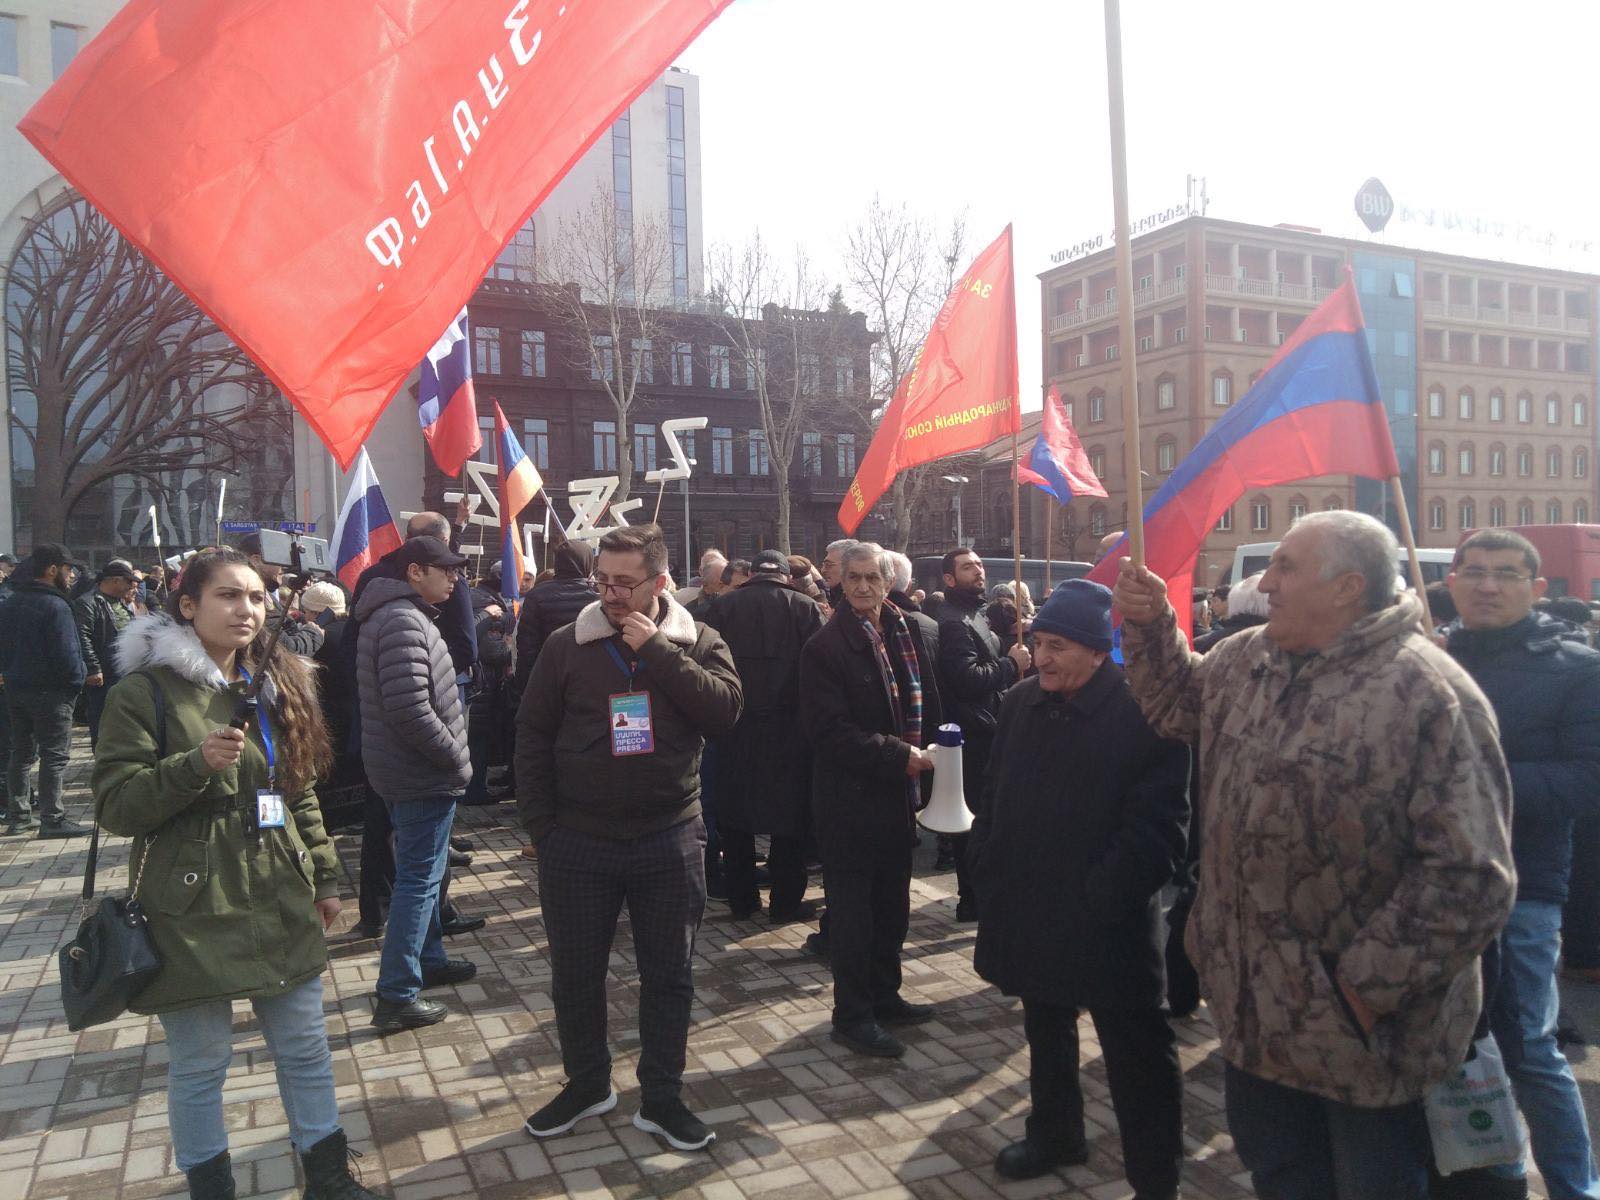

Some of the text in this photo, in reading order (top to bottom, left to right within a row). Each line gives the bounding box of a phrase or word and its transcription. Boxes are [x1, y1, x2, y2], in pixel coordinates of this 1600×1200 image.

[1362, 192, 1391, 217] BW
[616, 737, 646, 746] ПРЕССА
[616, 744, 642, 753] PRESS
